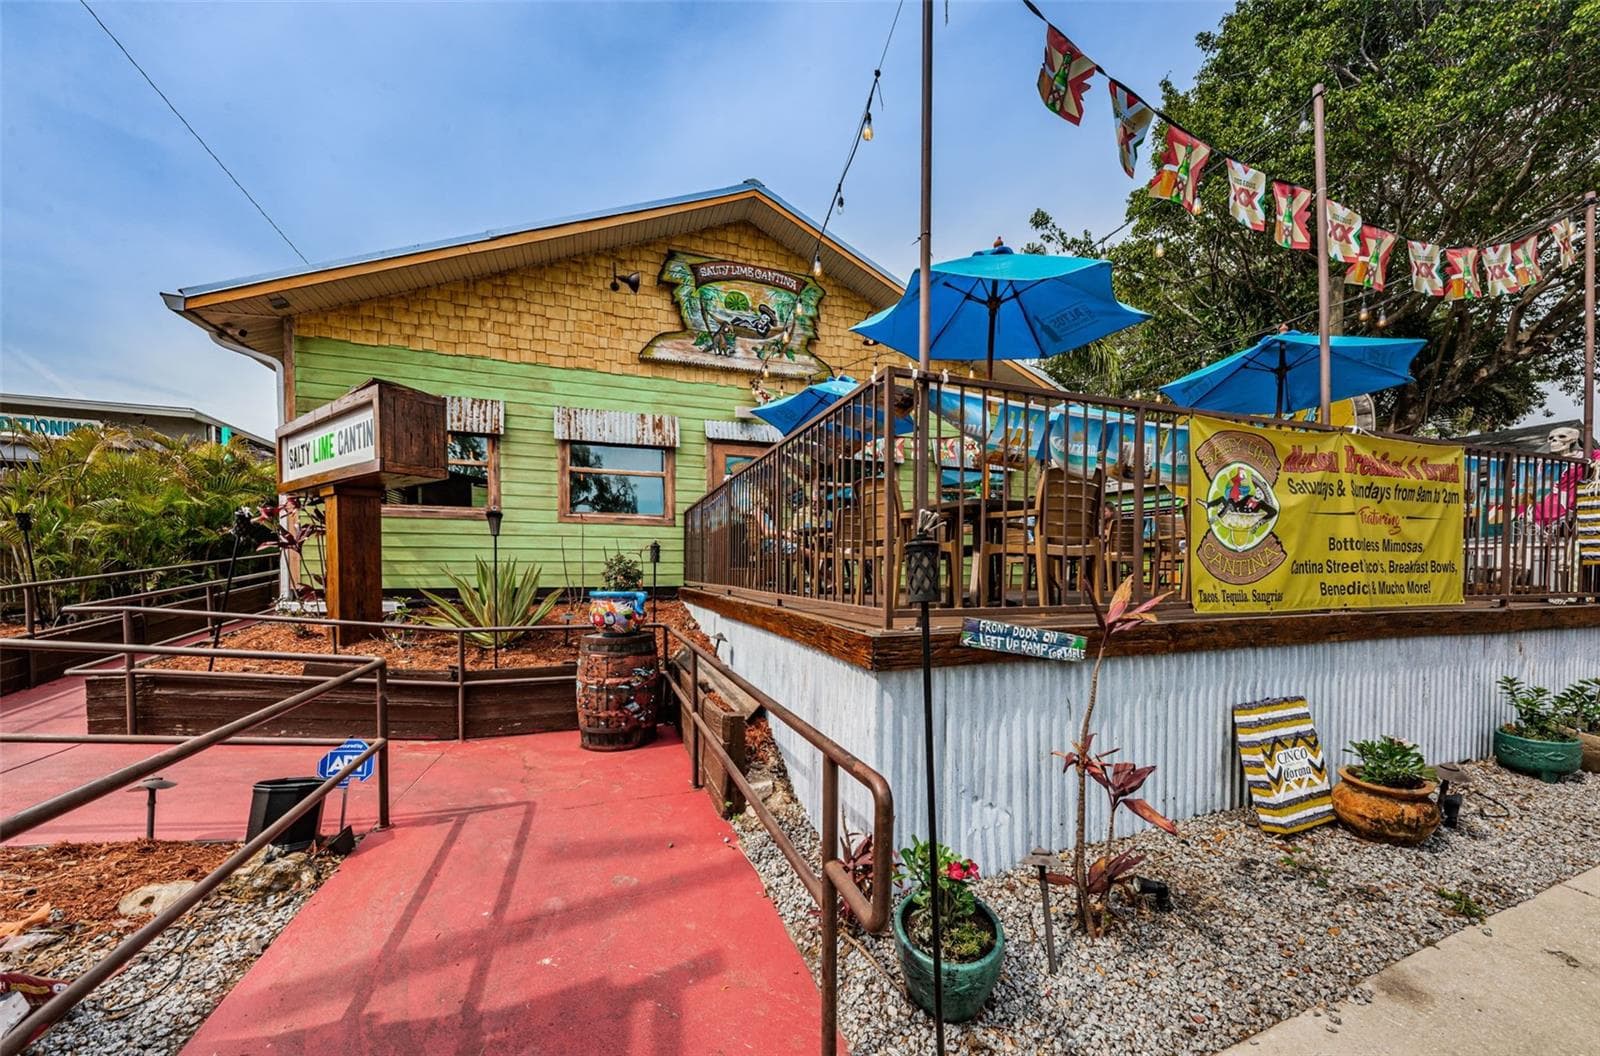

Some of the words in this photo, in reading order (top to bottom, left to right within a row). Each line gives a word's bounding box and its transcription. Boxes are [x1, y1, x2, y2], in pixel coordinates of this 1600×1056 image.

[1232, 183, 1259, 211] XX
[1328, 219, 1355, 244] XX
[699, 265, 730, 277] SALTY
[731, 265, 755, 278] LIME
[754, 269, 797, 290] CANTINA
[289, 442, 311, 470] SALTY
[313, 432, 335, 463] LIME
[1203, 437, 1243, 465] SALTY
[1247, 440, 1274, 470] LIME
[1337, 479, 1346, 497] &
[1351, 480, 1392, 504] Sundays
[1394, 483, 1416, 502] from
[1416, 486, 1433, 502] 9am
[1433, 488, 1441, 503] to
[1442, 488, 1460, 507] 2pm
[1358, 505, 1402, 535] Featuring
[1382, 539, 1425, 554] Mimosas,
[1203, 543, 1279, 576] CANTINA
[1291, 559, 1323, 574] Cantina
[1326, 559, 1364, 574] Street
[1388, 560, 1429, 574] Breakfast
[1430, 560, 1457, 575] Bowls,
[1378, 581, 1405, 595] Mucho
[1407, 580, 1431, 594] More!
[979, 620, 1010, 635] FRONT
[1013, 626, 1038, 642] DOOR
[1042, 631, 1058, 643] ON
[979, 633, 1004, 649] LEFT
[1006, 636, 1020, 651] UP
[1021, 639, 1048, 656] RAMP
[1276, 747, 1308, 765] CINCO
[1283, 765, 1312, 782] Corona
